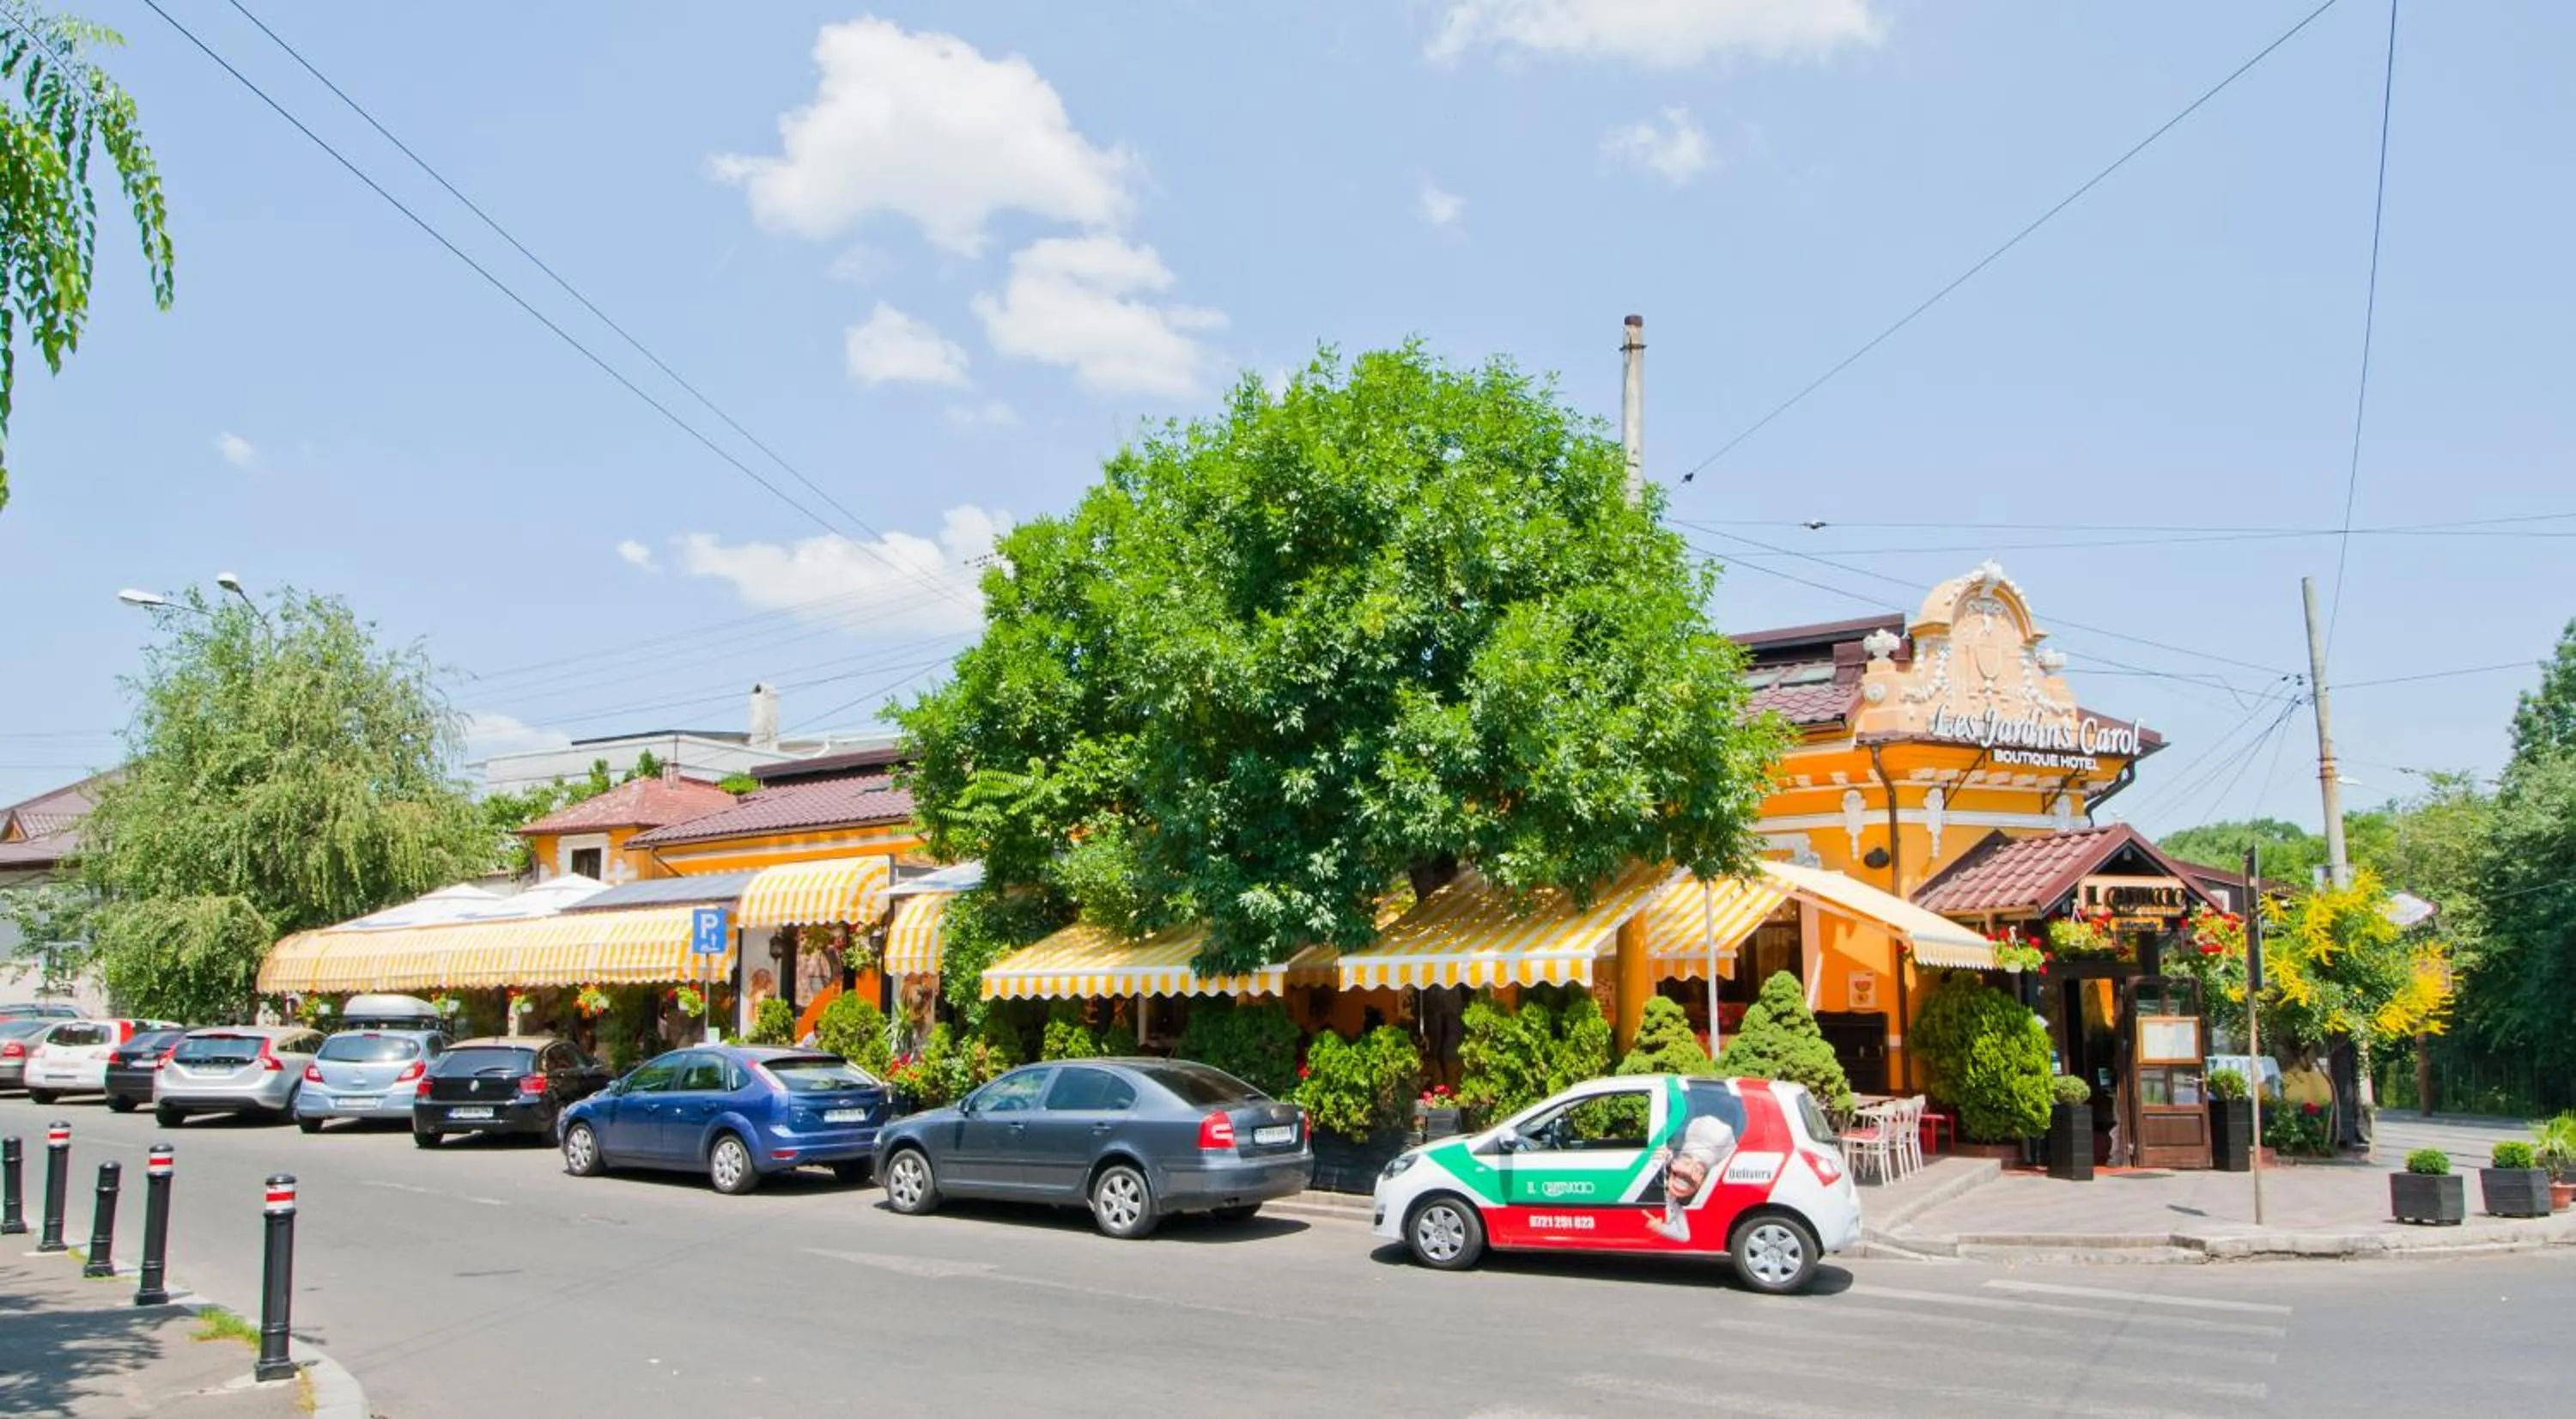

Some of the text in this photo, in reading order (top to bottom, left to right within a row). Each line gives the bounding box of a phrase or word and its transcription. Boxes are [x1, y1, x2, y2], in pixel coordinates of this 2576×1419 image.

[1932, 703, 1977, 740] Les
[2079, 716, 2143, 756] Carol
[1993, 748, 2100, 770] BOUTIQUE HOTEL
[700, 913, 719, 939] P
